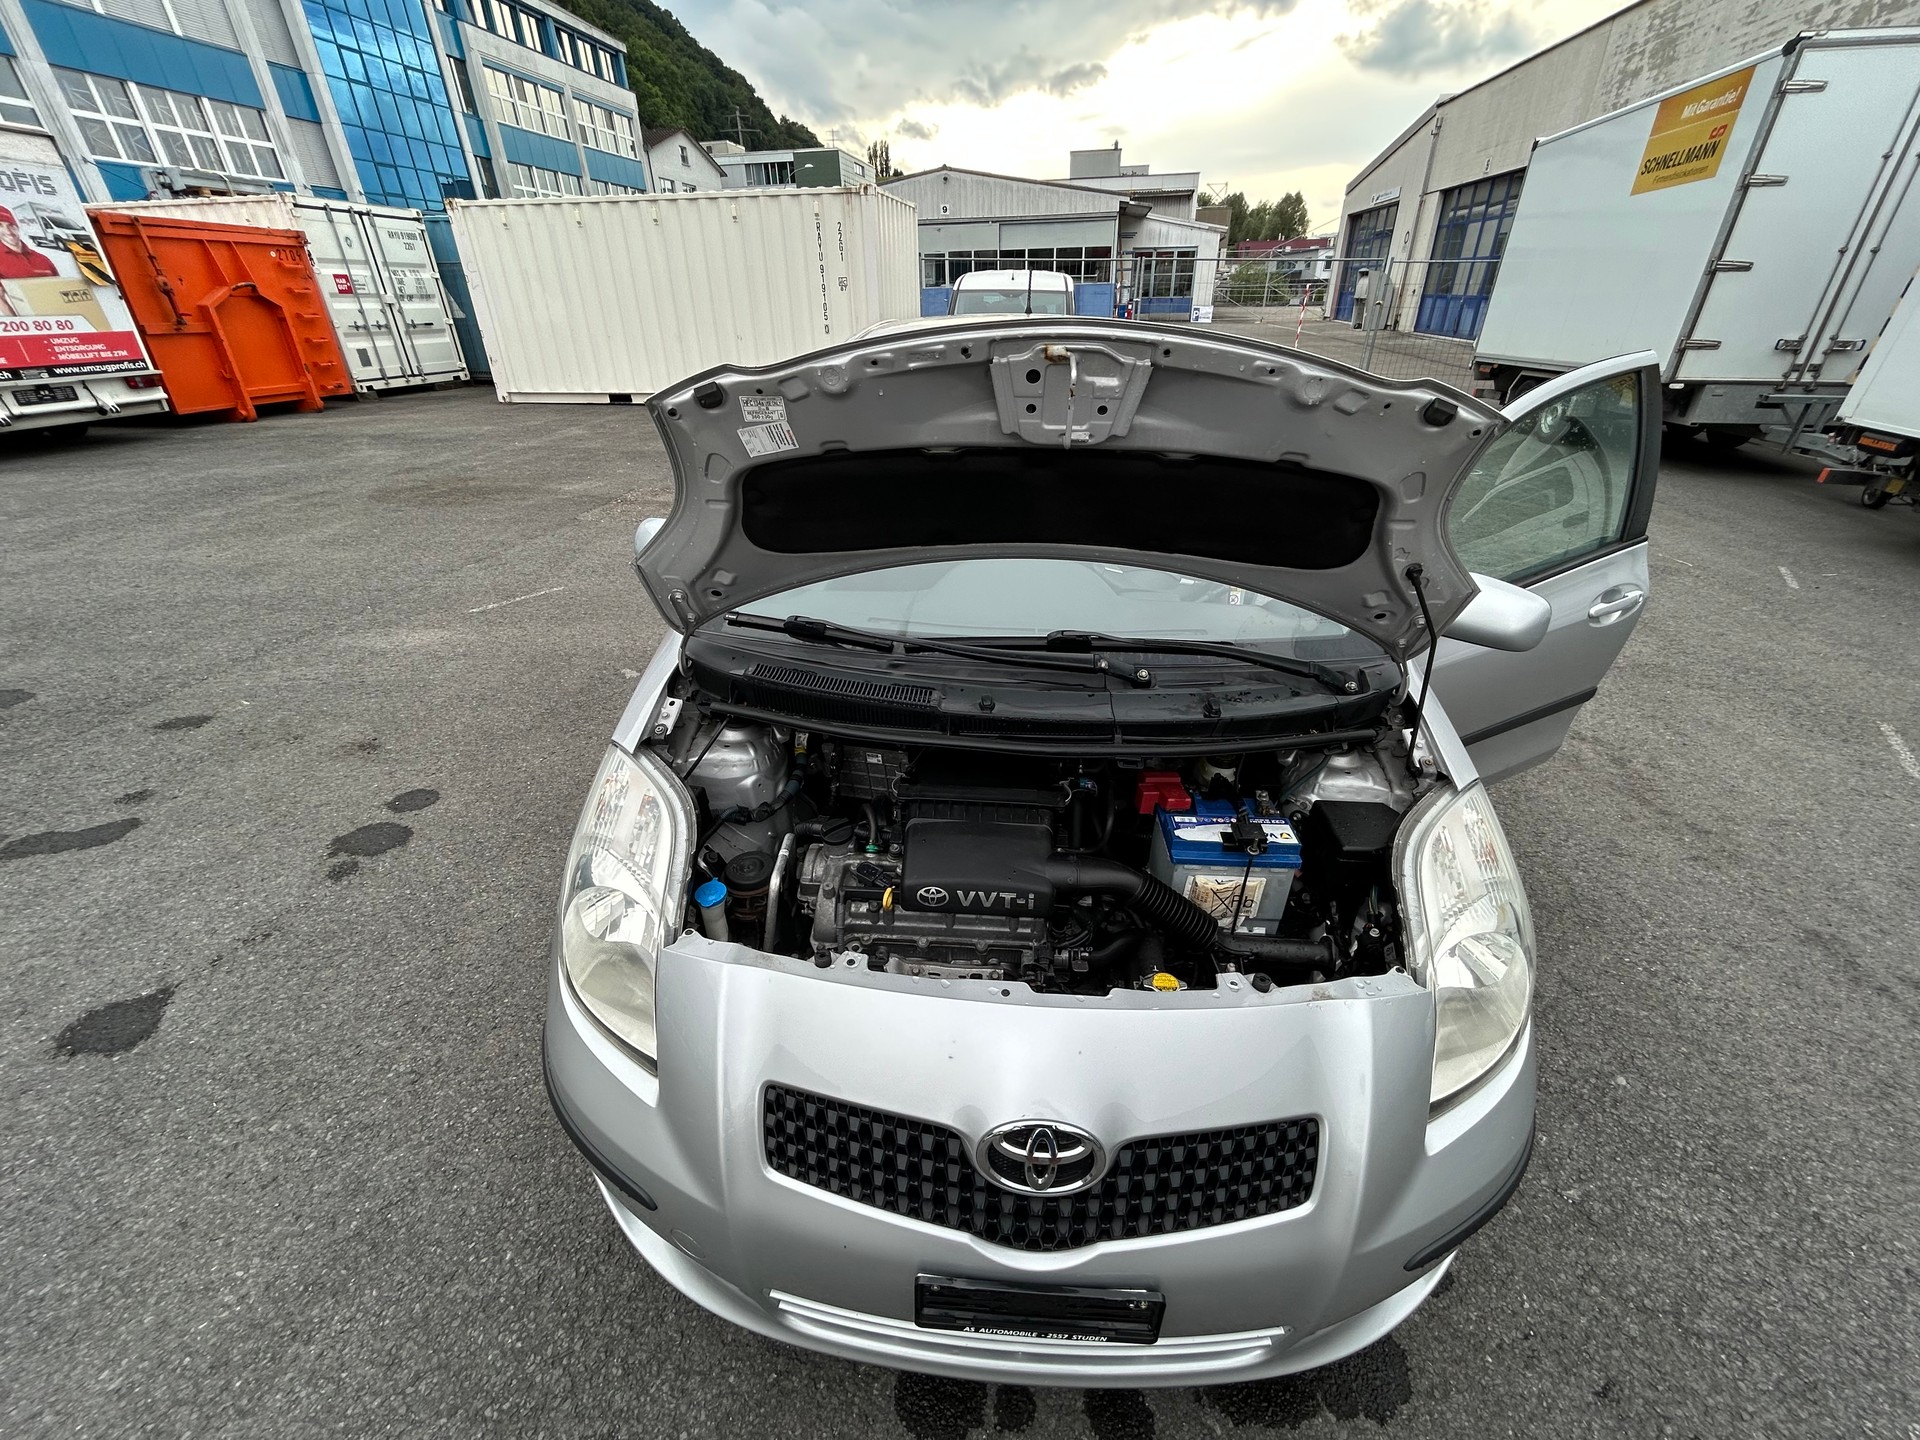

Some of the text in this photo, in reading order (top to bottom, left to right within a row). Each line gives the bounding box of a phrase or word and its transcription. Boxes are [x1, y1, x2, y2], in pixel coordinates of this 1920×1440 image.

[1681, 86, 1742, 119] Mit Garantie!
[1641, 139, 1721, 175] SCHNELLMANN
[942, 205, 948, 213] 9
[816, 221, 824, 261] RAYU
[819, 264, 829, 321] 919105
[2, 320, 74, 332] 200 80 80
[50, 336, 80, 345] UMZUG
[54, 343, 107, 353] ENTSORGUNG
[53, 361, 147, 375] www.umzugprofis.ch
[957, 891, 1034, 910] VVT-i
[979, 1327, 1038, 1338] AUTOMOBILE
[1071, 1334, 1108, 1342] STUDEN
